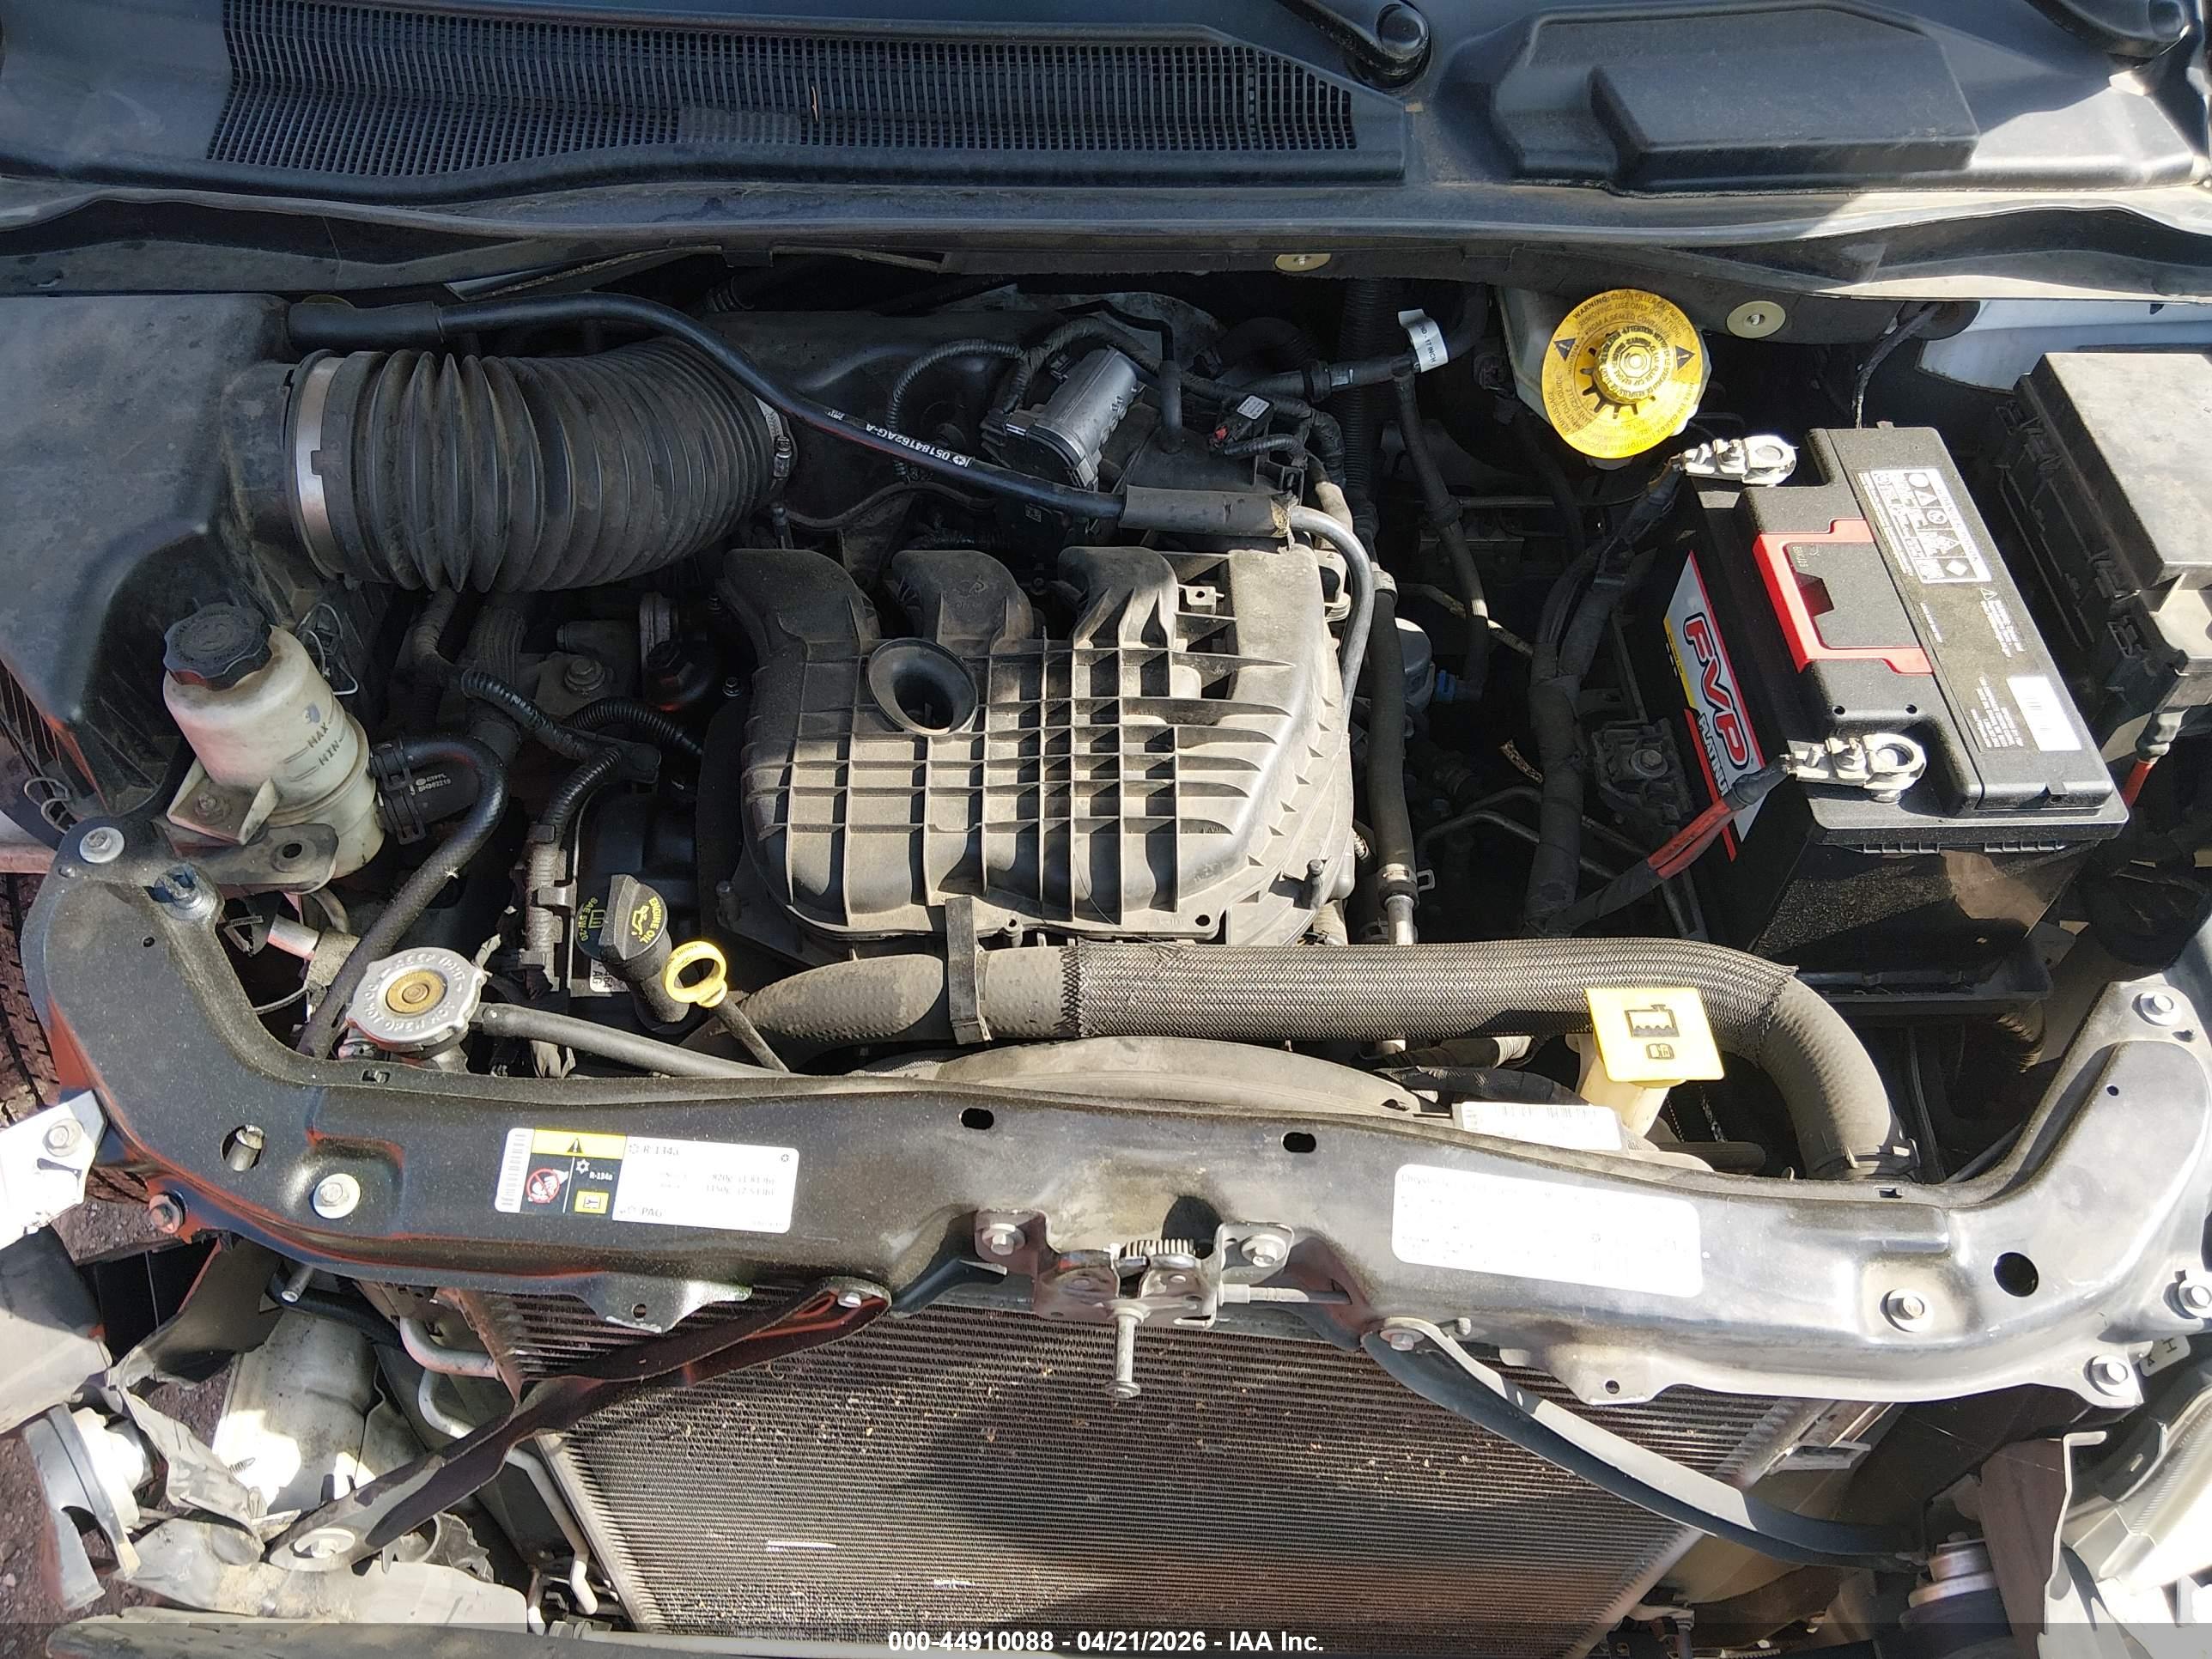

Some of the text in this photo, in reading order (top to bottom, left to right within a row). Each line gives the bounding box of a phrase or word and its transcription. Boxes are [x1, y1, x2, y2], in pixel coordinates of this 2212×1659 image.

[1571, 295, 1609, 319] WARNING:
[1630, 302, 1648, 313] ONLY
[1426, 346, 1437, 363] INCH
[866, 424, 950, 461] 05184162AG-A
[1683, 612, 1750, 769] FVP
[307, 723, 330, 748] MAX
[318, 739, 341, 766] MIN
[577, 897, 598, 941] SAE 5W-20
[640, 896, 660, 945] ENGINE OIL
[592, 970, 602, 984] AG
[589, 1171, 614, 1182] R-134a
